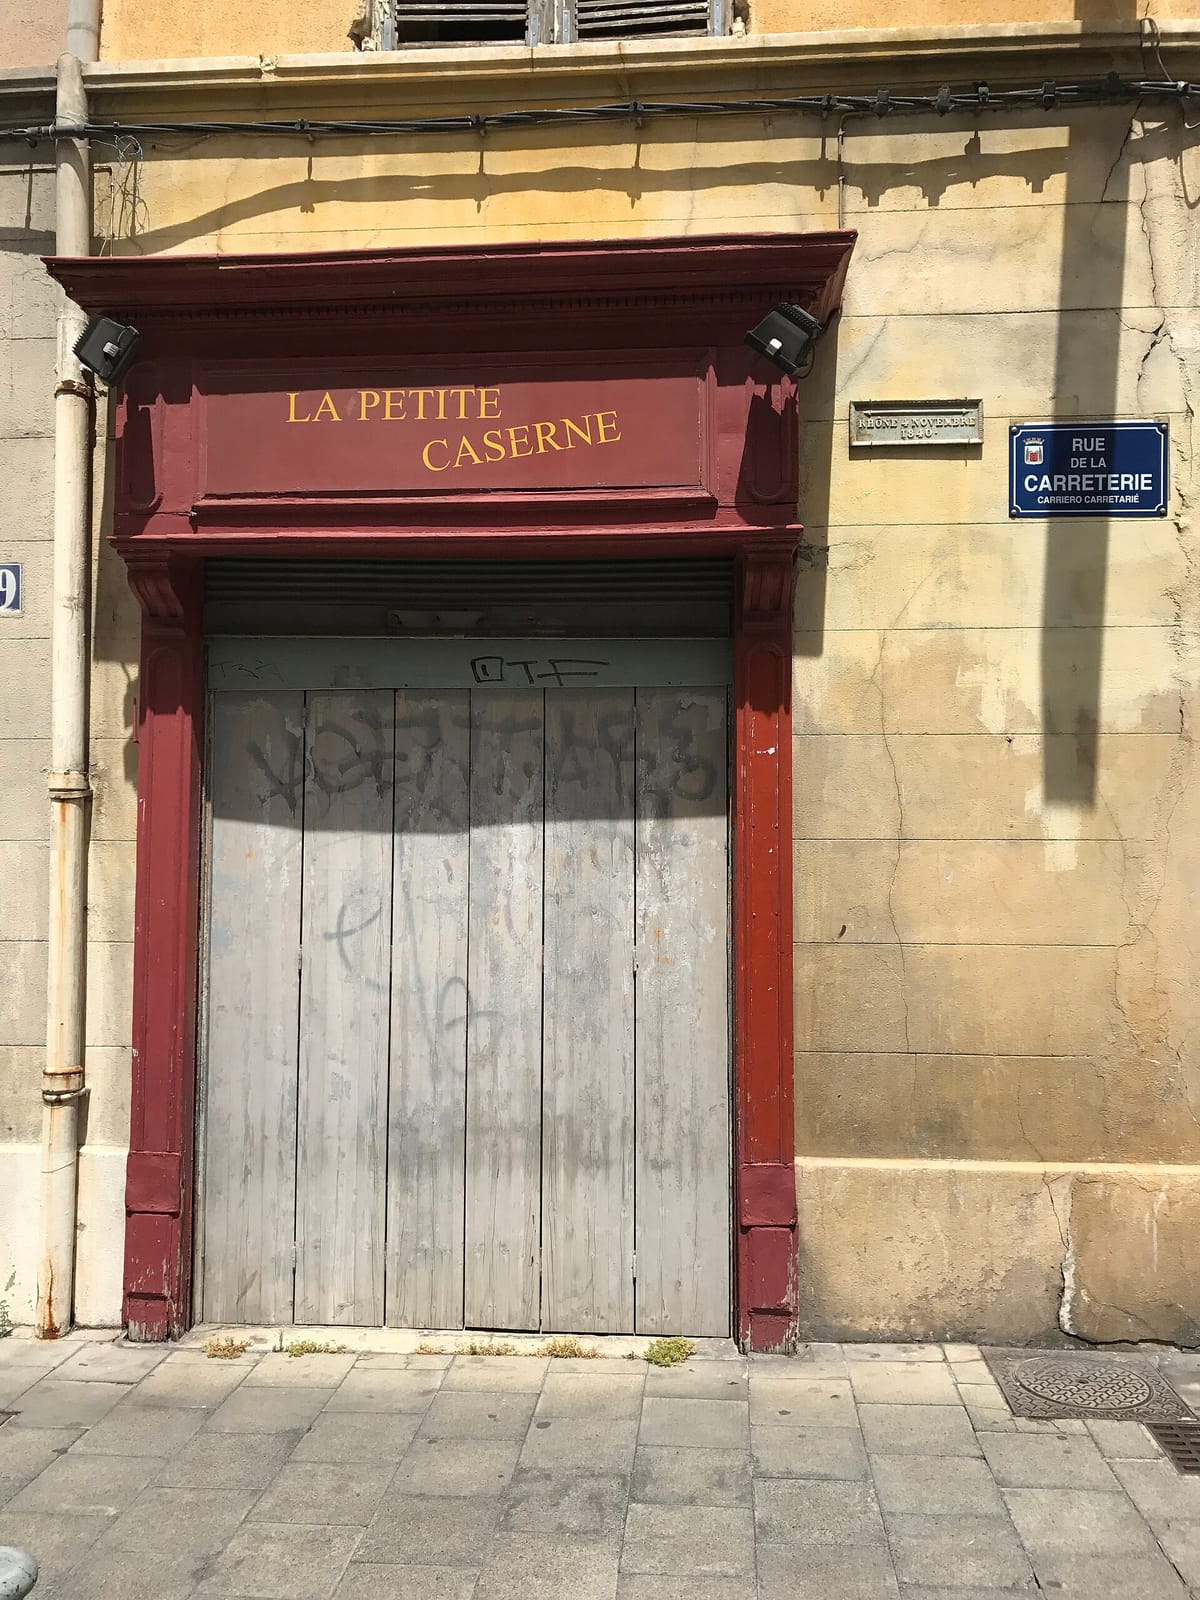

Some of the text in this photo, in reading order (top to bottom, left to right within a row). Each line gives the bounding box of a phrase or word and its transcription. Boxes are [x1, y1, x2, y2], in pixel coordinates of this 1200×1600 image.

[285, 388, 502, 423] LA PETITE
[900, 418, 910, 428] 4
[911, 416, 976, 428] NOVEMBRE
[421, 410, 622, 472] CASERNE
[1072, 437, 1106, 452] RUE
[1070, 457, 1107, 469] DE LA
[1023, 473, 1153, 493] CARRETERIE
[1037, 493, 1140, 505] CARRIERO CARRETARIÉ
[0, 568, 17, 609] 9
